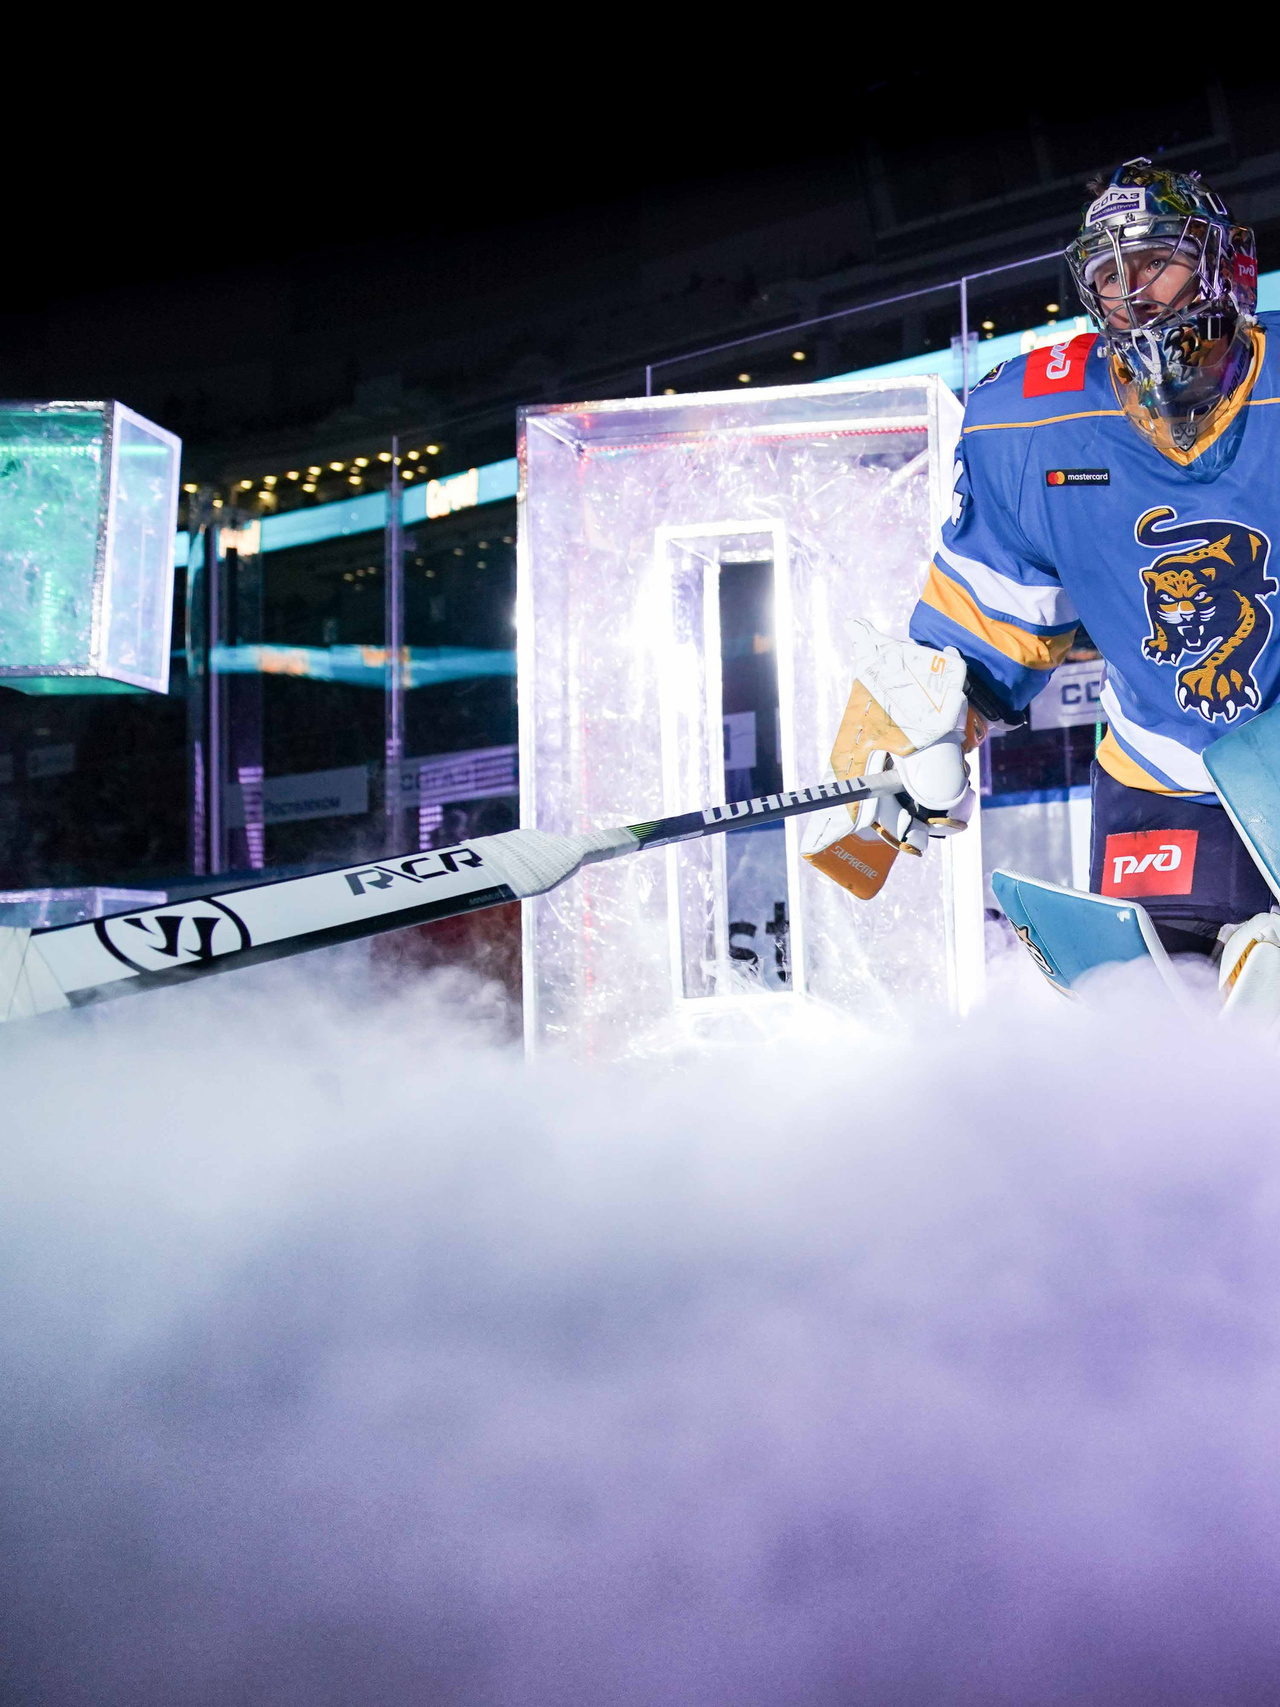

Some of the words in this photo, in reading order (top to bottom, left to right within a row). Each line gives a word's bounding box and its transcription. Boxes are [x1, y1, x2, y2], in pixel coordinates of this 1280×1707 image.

[1092, 192, 1140, 212] СОГАЗ
[1067, 473, 1109, 481] mastercard
[830, 845, 879, 880] SUPREME
